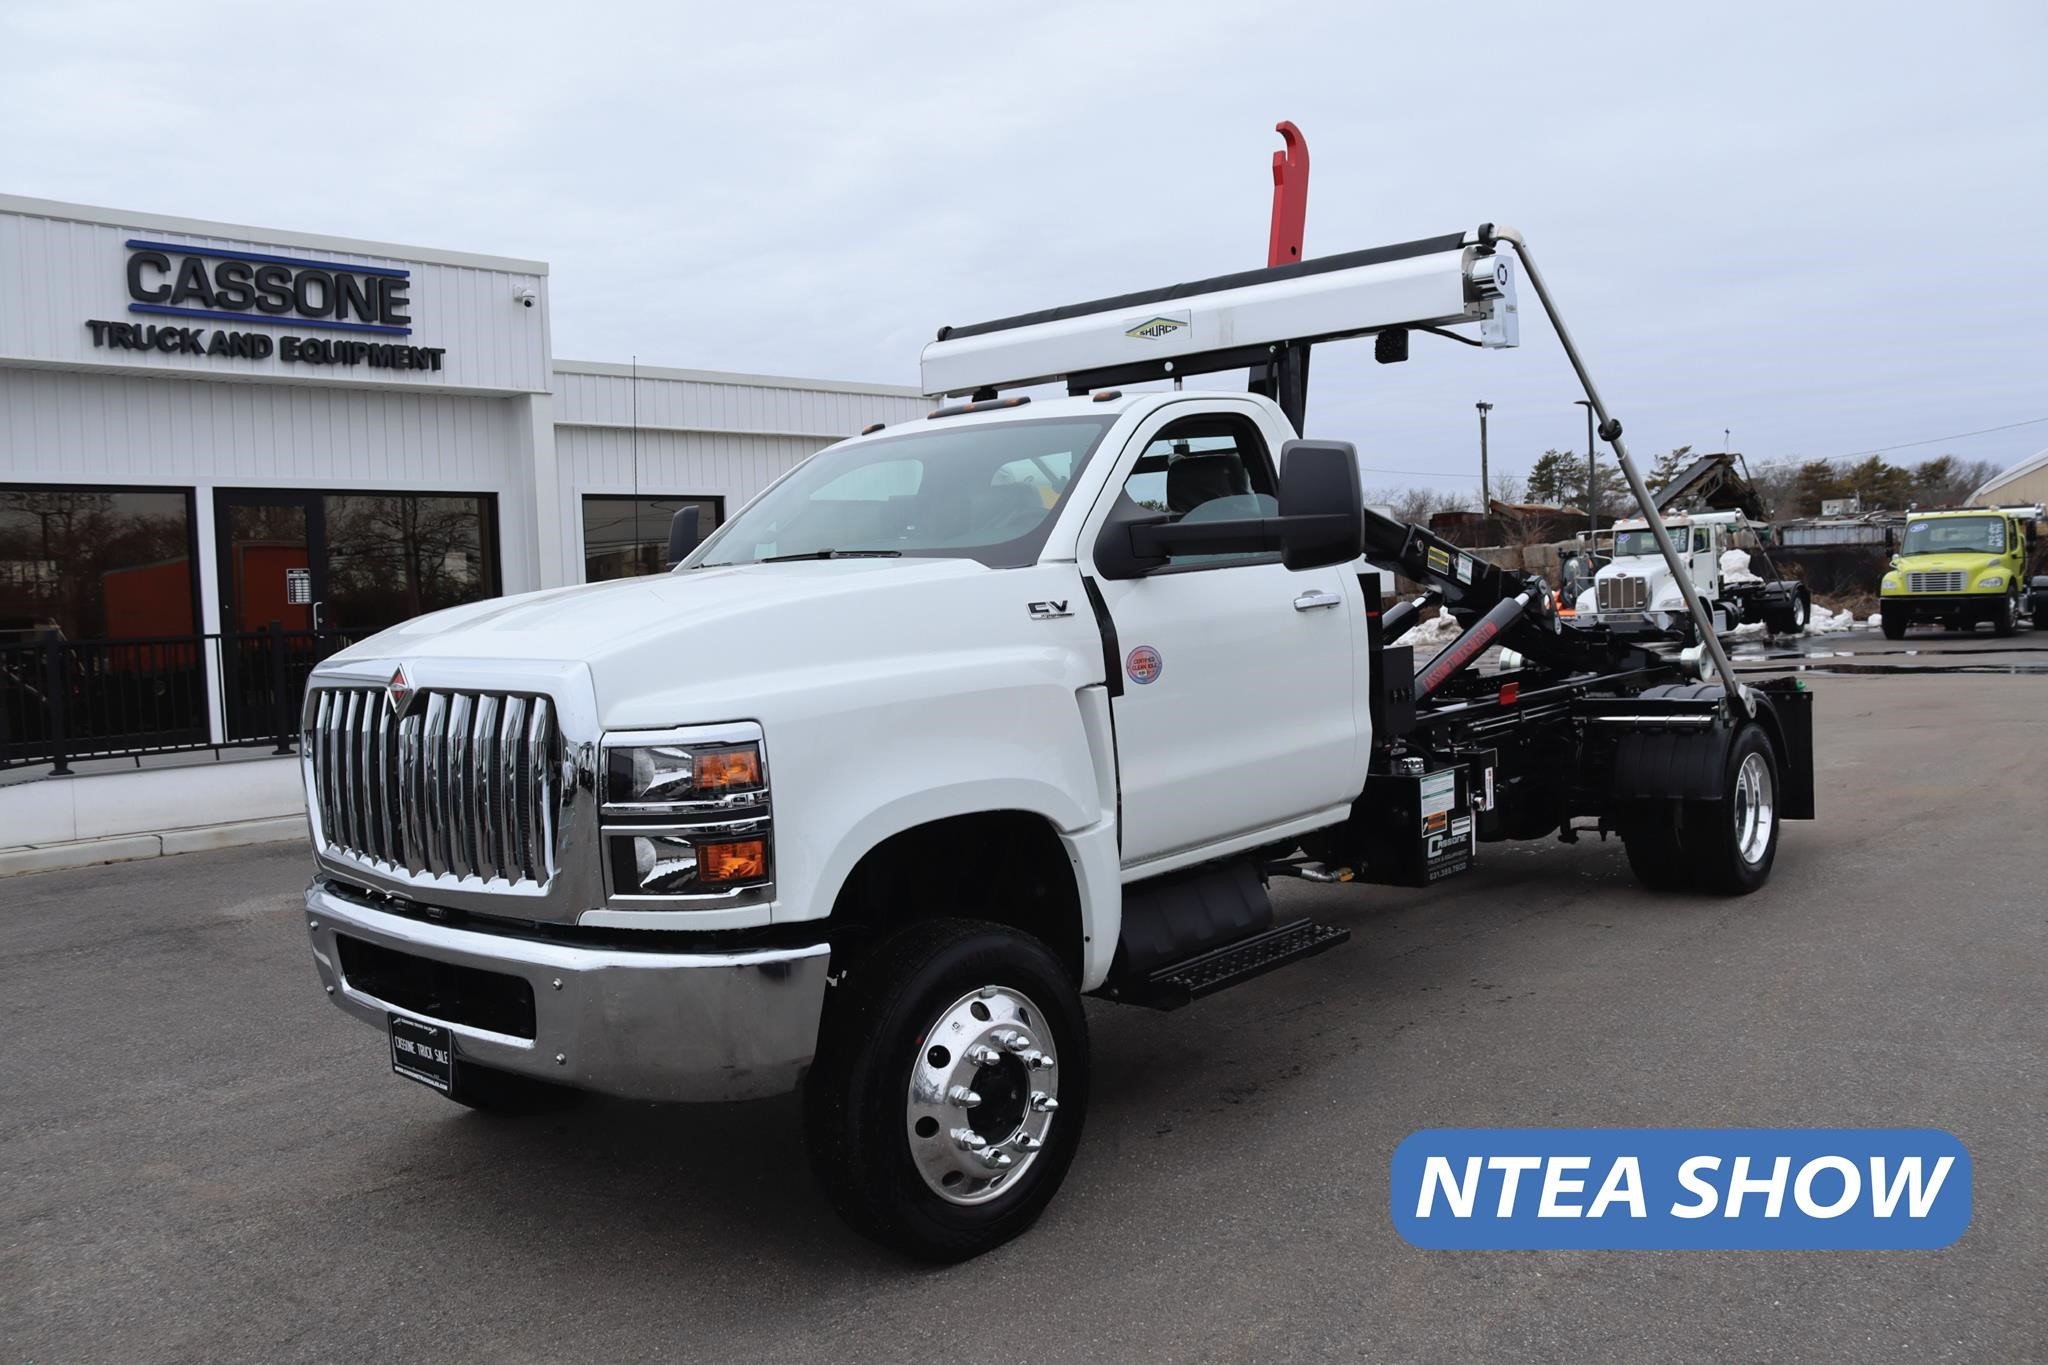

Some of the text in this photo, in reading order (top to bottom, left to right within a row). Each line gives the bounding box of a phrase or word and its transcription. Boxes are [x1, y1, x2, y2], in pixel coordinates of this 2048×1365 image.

[127, 251, 411, 324] CASSONE
[86, 319, 446, 371] TRUCK AND EQUIPMENT
[1140, 325, 1178, 337] SHURCO
[1027, 600, 1068, 614] CV
